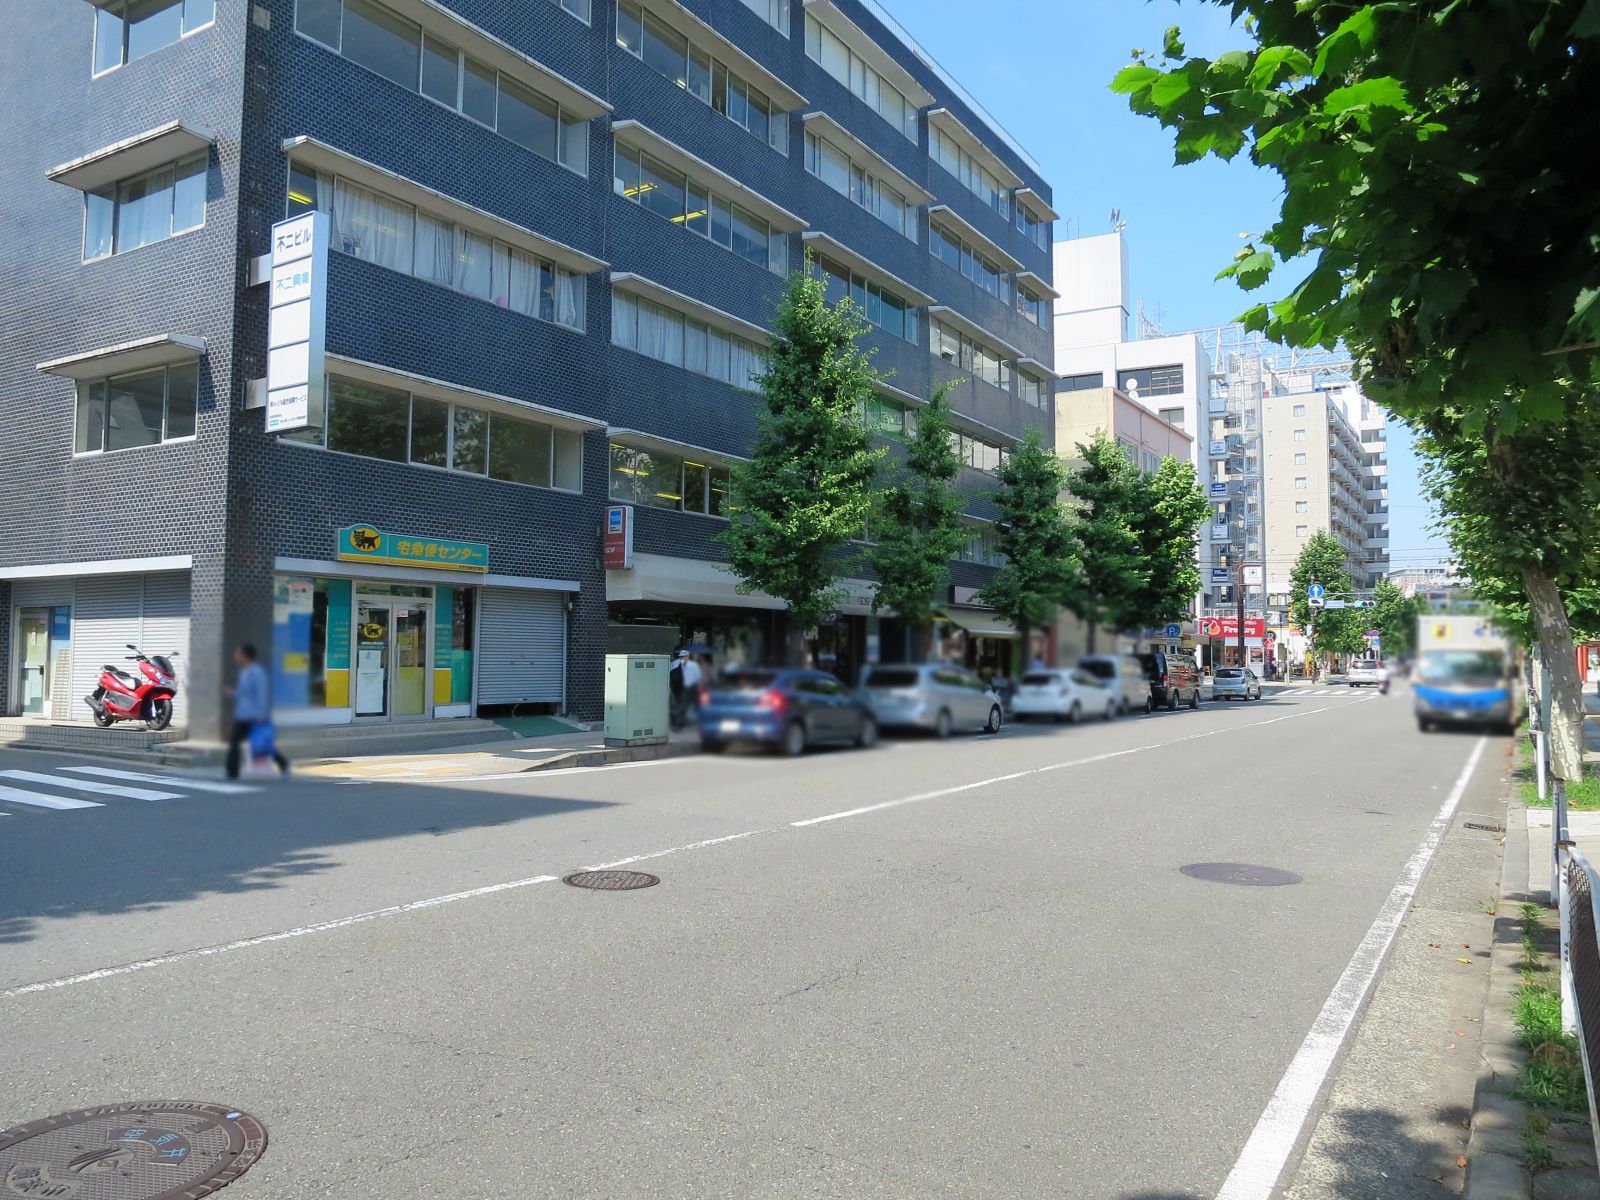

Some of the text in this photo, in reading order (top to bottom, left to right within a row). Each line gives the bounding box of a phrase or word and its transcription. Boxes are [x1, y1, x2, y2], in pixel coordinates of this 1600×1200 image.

[276, 228, 311, 252] 不二ビル
[397, 540, 482, 561] 宅急便センター
[1223, 625, 1255, 635] Fireurg
